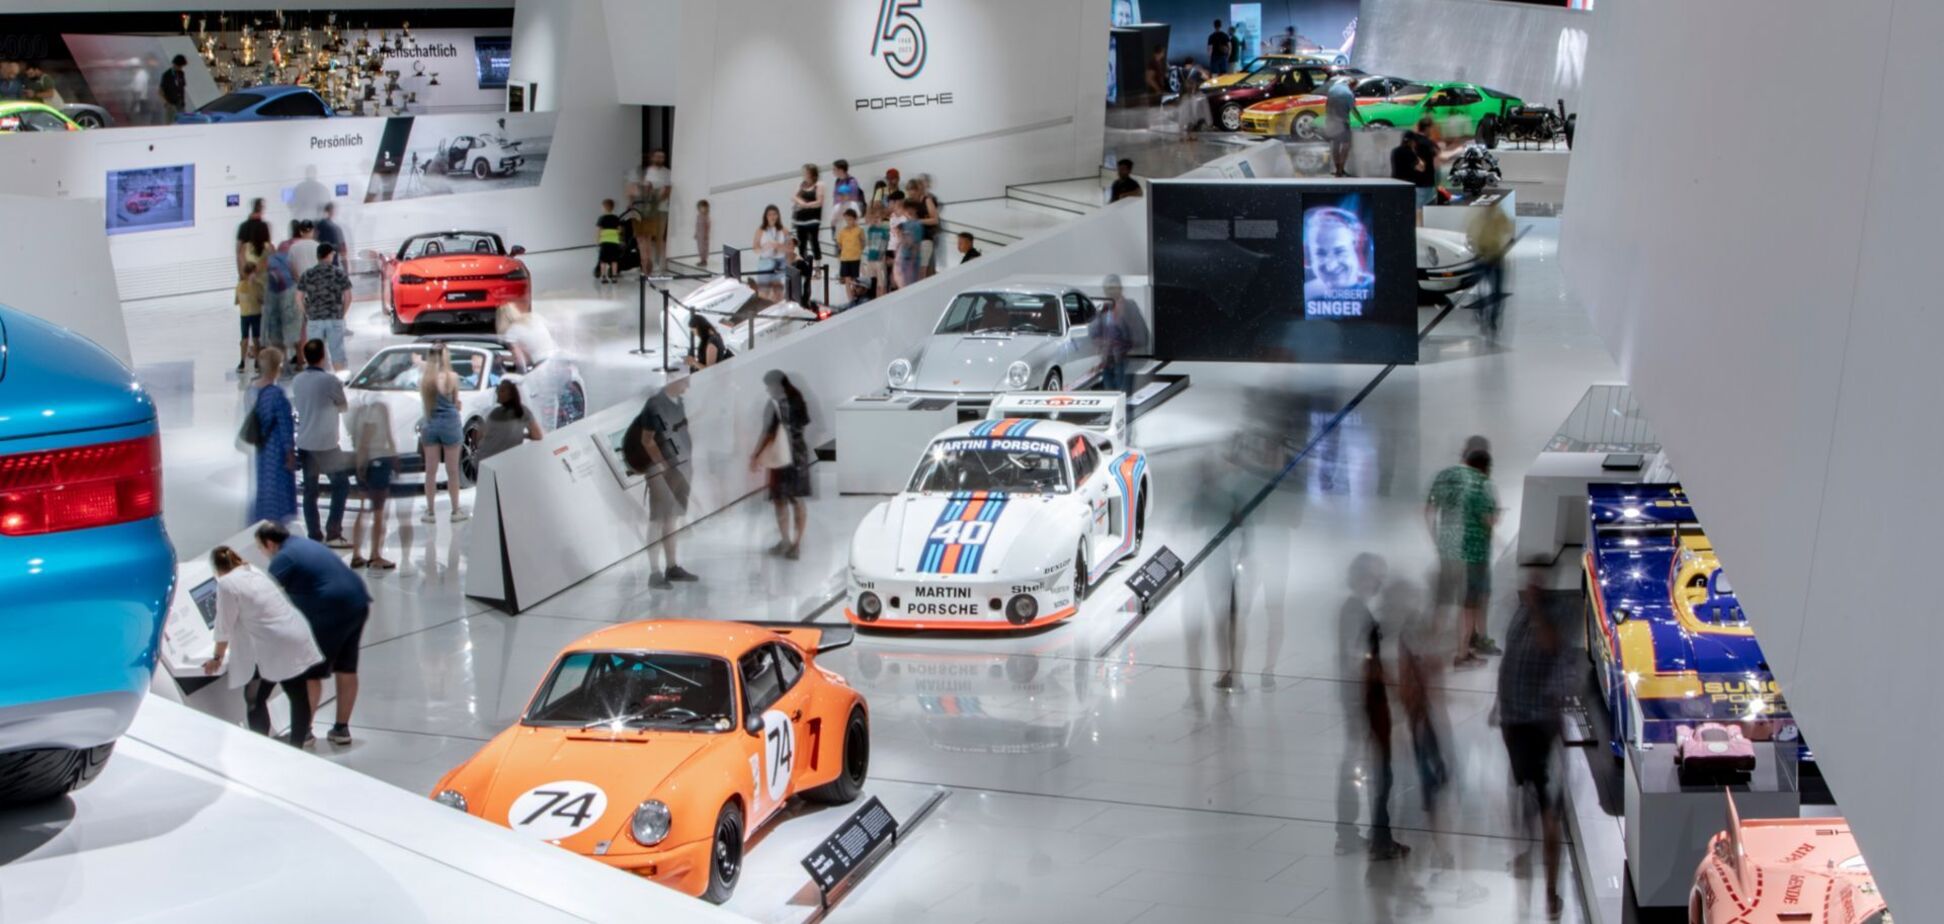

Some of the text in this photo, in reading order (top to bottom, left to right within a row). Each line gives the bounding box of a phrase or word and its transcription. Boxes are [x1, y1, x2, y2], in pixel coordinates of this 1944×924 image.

[855, 92, 954, 111] PORSCHE
[310, 133, 363, 149] Persönlich
[1324, 288, 1369, 300] NORBERT
[1307, 301, 1362, 316] SINGER
[1018, 398, 1101, 407] MARTINI
[933, 439, 1060, 456] MARTINI PORSCHE
[929, 520, 994, 545] 40
[915, 586, 972, 598] MARTINI
[907, 603, 979, 615] PORSCHE
[767, 718, 793, 787] 74
[518, 790, 597, 827] 74
